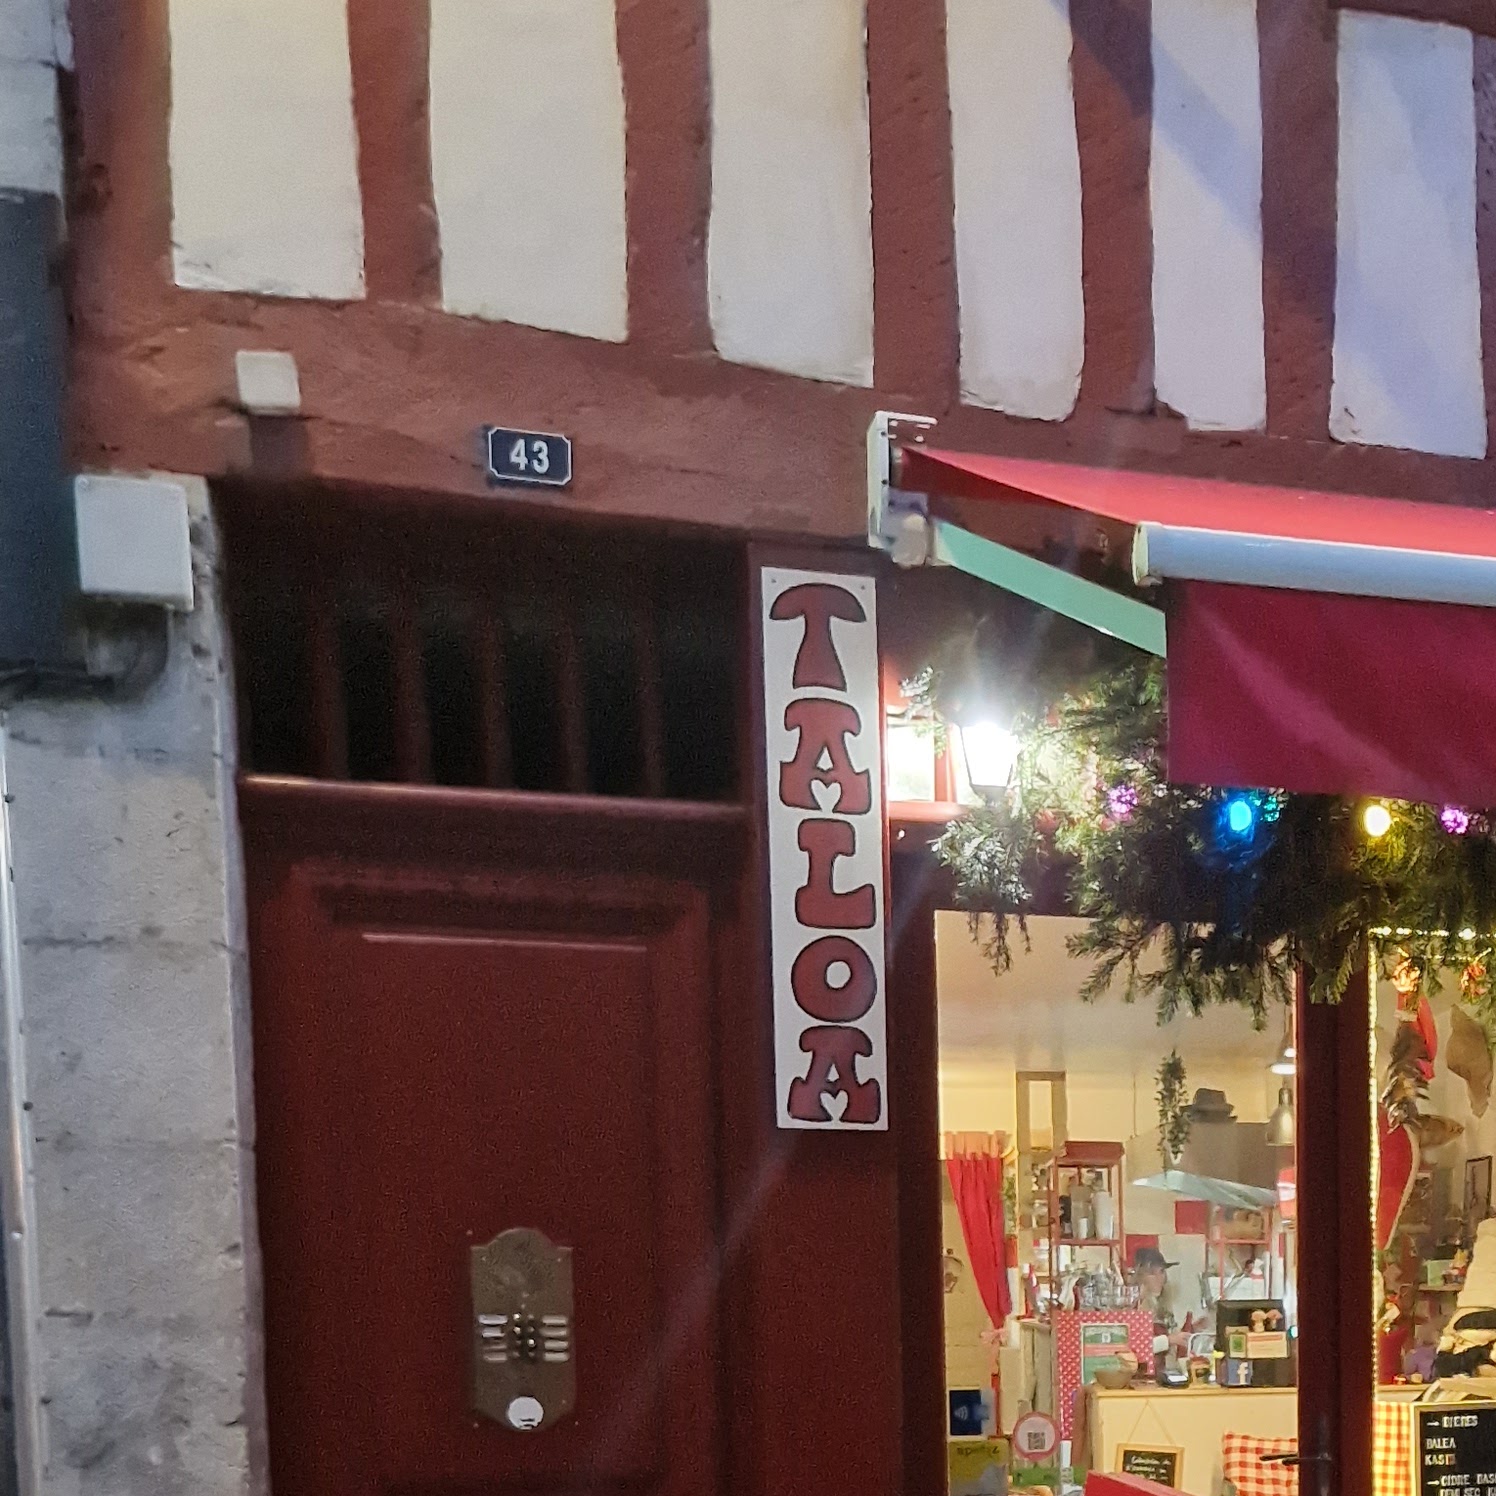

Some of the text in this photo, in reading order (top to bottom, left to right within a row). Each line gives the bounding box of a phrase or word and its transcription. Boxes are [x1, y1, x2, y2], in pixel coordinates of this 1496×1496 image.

[508, 438, 550, 474] 43
[768, 582, 881, 1124] TALOA
[1426, 1437, 1456, 1449] BALEA
